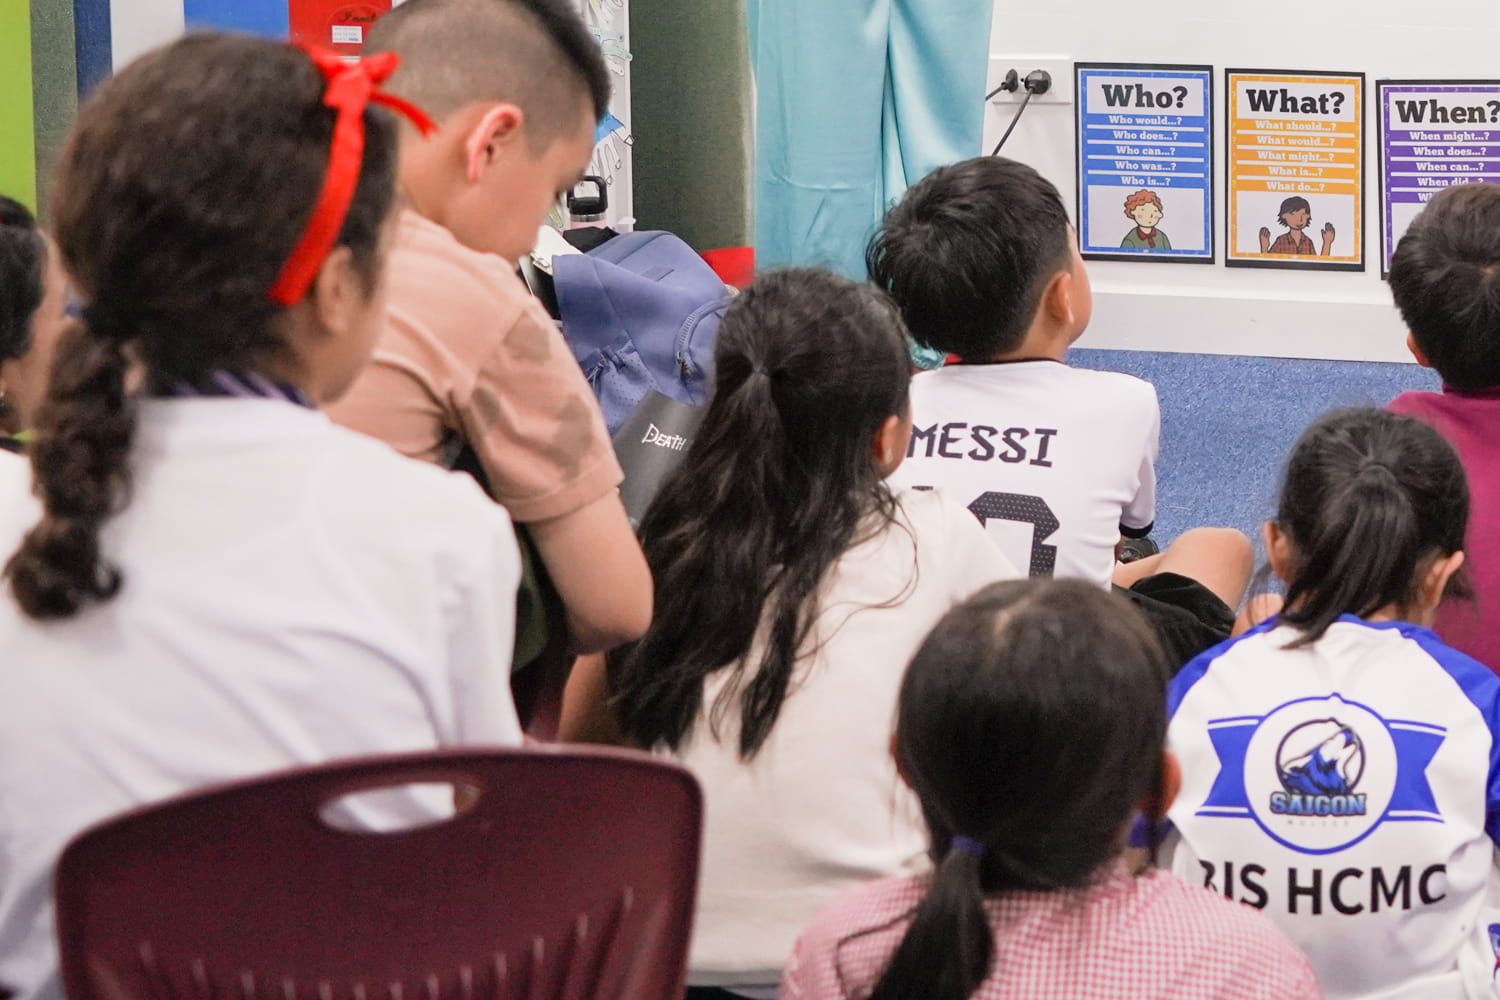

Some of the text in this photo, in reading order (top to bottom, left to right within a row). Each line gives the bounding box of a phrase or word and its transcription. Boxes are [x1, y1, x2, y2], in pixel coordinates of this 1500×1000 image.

[1101, 83, 1188, 109] Who?
[1246, 88, 1345, 115] What?
[1108, 115, 1182, 126] Who would...?
[1255, 119, 1337, 132] What should...?
[1113, 130, 1178, 141] Who does...?
[1256, 135, 1335, 147] What would...?
[1409, 131, 1490, 142] When might...?
[1116, 145, 1175, 156] Who can...?
[1413, 146, 1487, 156] When does...?
[1258, 150, 1334, 163] What might...?
[1115, 160, 1177, 171] Who was...?
[1416, 162, 1485, 172] When can...?
[1268, 166, 1323, 177] What is...?
[1121, 176, 1171, 187] Who is...?
[1266, 181, 1325, 192] What do...?
[1417, 177, 1449, 187] When
[641, 423, 687, 451] DEATH
[906, 422, 1058, 468] MESSI
[1270, 791, 1367, 816] SAIGON
[1287, 863, 1447, 916] HCMC
